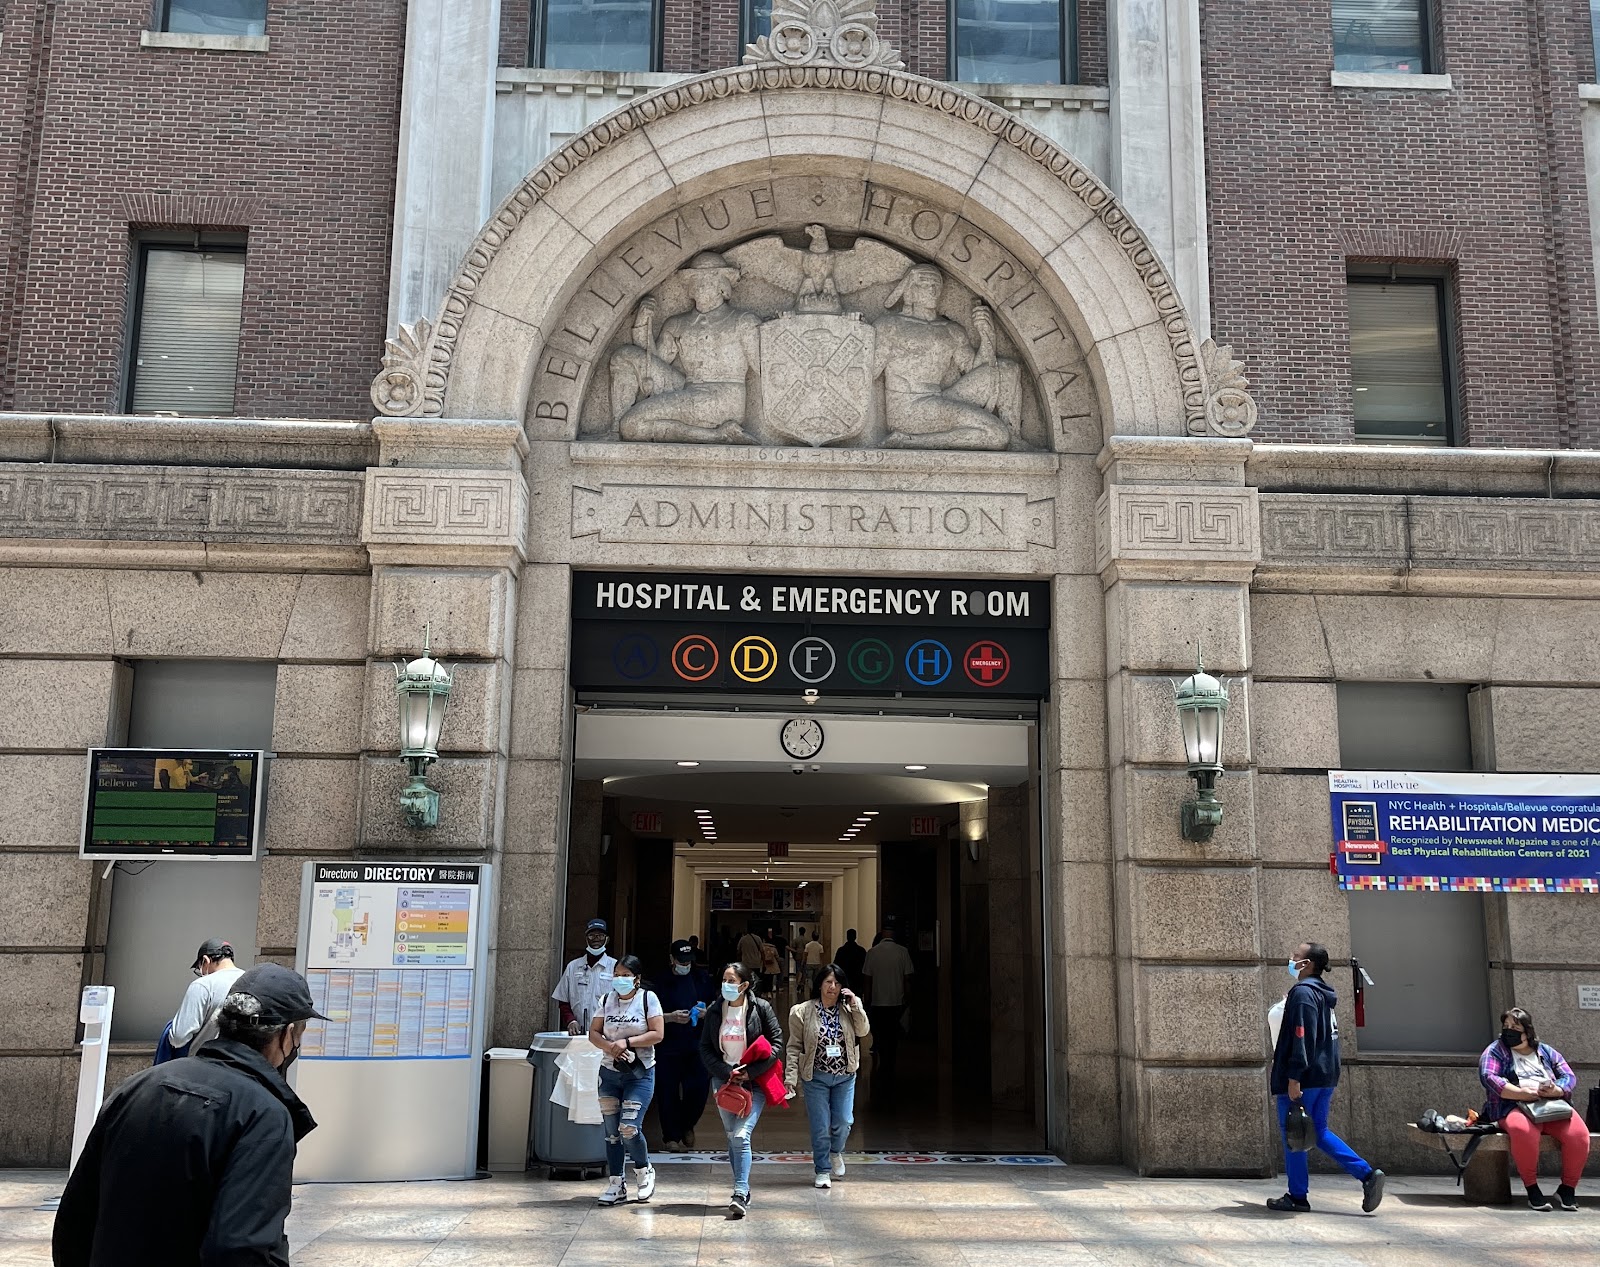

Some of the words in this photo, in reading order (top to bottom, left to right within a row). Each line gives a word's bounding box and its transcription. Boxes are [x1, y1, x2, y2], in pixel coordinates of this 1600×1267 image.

[535, 187, 774, 423] BELLEVUE
[864, 189, 1093, 435] HOSPITAL
[623, 500, 1006, 536] ADMINISTRATION
[596, 582, 730, 611] HOSPITAL
[740, 585, 761, 612] &
[772, 586, 941, 615] EMERGENCY
[951, 590, 1030, 617] ROM
[682, 644, 706, 672] C
[743, 645, 768, 672] D
[804, 646, 823, 674] F
[858, 647, 883, 675] G
[917, 648, 941, 676] H
[98, 778, 138, 788] Bellevue
[1372, 779, 1419, 790] Bellevue
[1388, 800, 1412, 811] NYC
[1413, 800, 1446, 811] Health
[1449, 802, 1456, 810] +
[1459, 801, 1548, 813] Hospitals/Bellevue
[1550, 802, 1600, 814] congratula
[636, 814, 658, 832] EXIT
[914, 816, 936, 834] EXIT
[1347, 818, 1373, 826] PHYSICAL
[1389, 815, 1536, 832] REHABILITATION
[1542, 817, 1600, 833] MEDIC
[1345, 842, 1379, 850] Newsweek
[1390, 835, 1440, 846] Recognized
[1441, 836, 1453, 847] by
[1455, 836, 1504, 845] Newsweek
[1505, 836, 1549, 847] Magazine
[1562, 839, 1578, 847] one
[1580, 837, 1589, 846] of
[768, 842, 788, 857] EXIT
[1391, 847, 1412, 856] Best
[1413, 847, 1450, 858] Physical
[1452, 847, 1516, 857] Rehabilitation
[1517, 848, 1554, 858] Centers
[1555, 848, 1566, 858] of
[1567, 849, 1590, 858] 2021
[319, 867, 359, 879] Directorio
[364, 866, 436, 882] DIRECTORY
